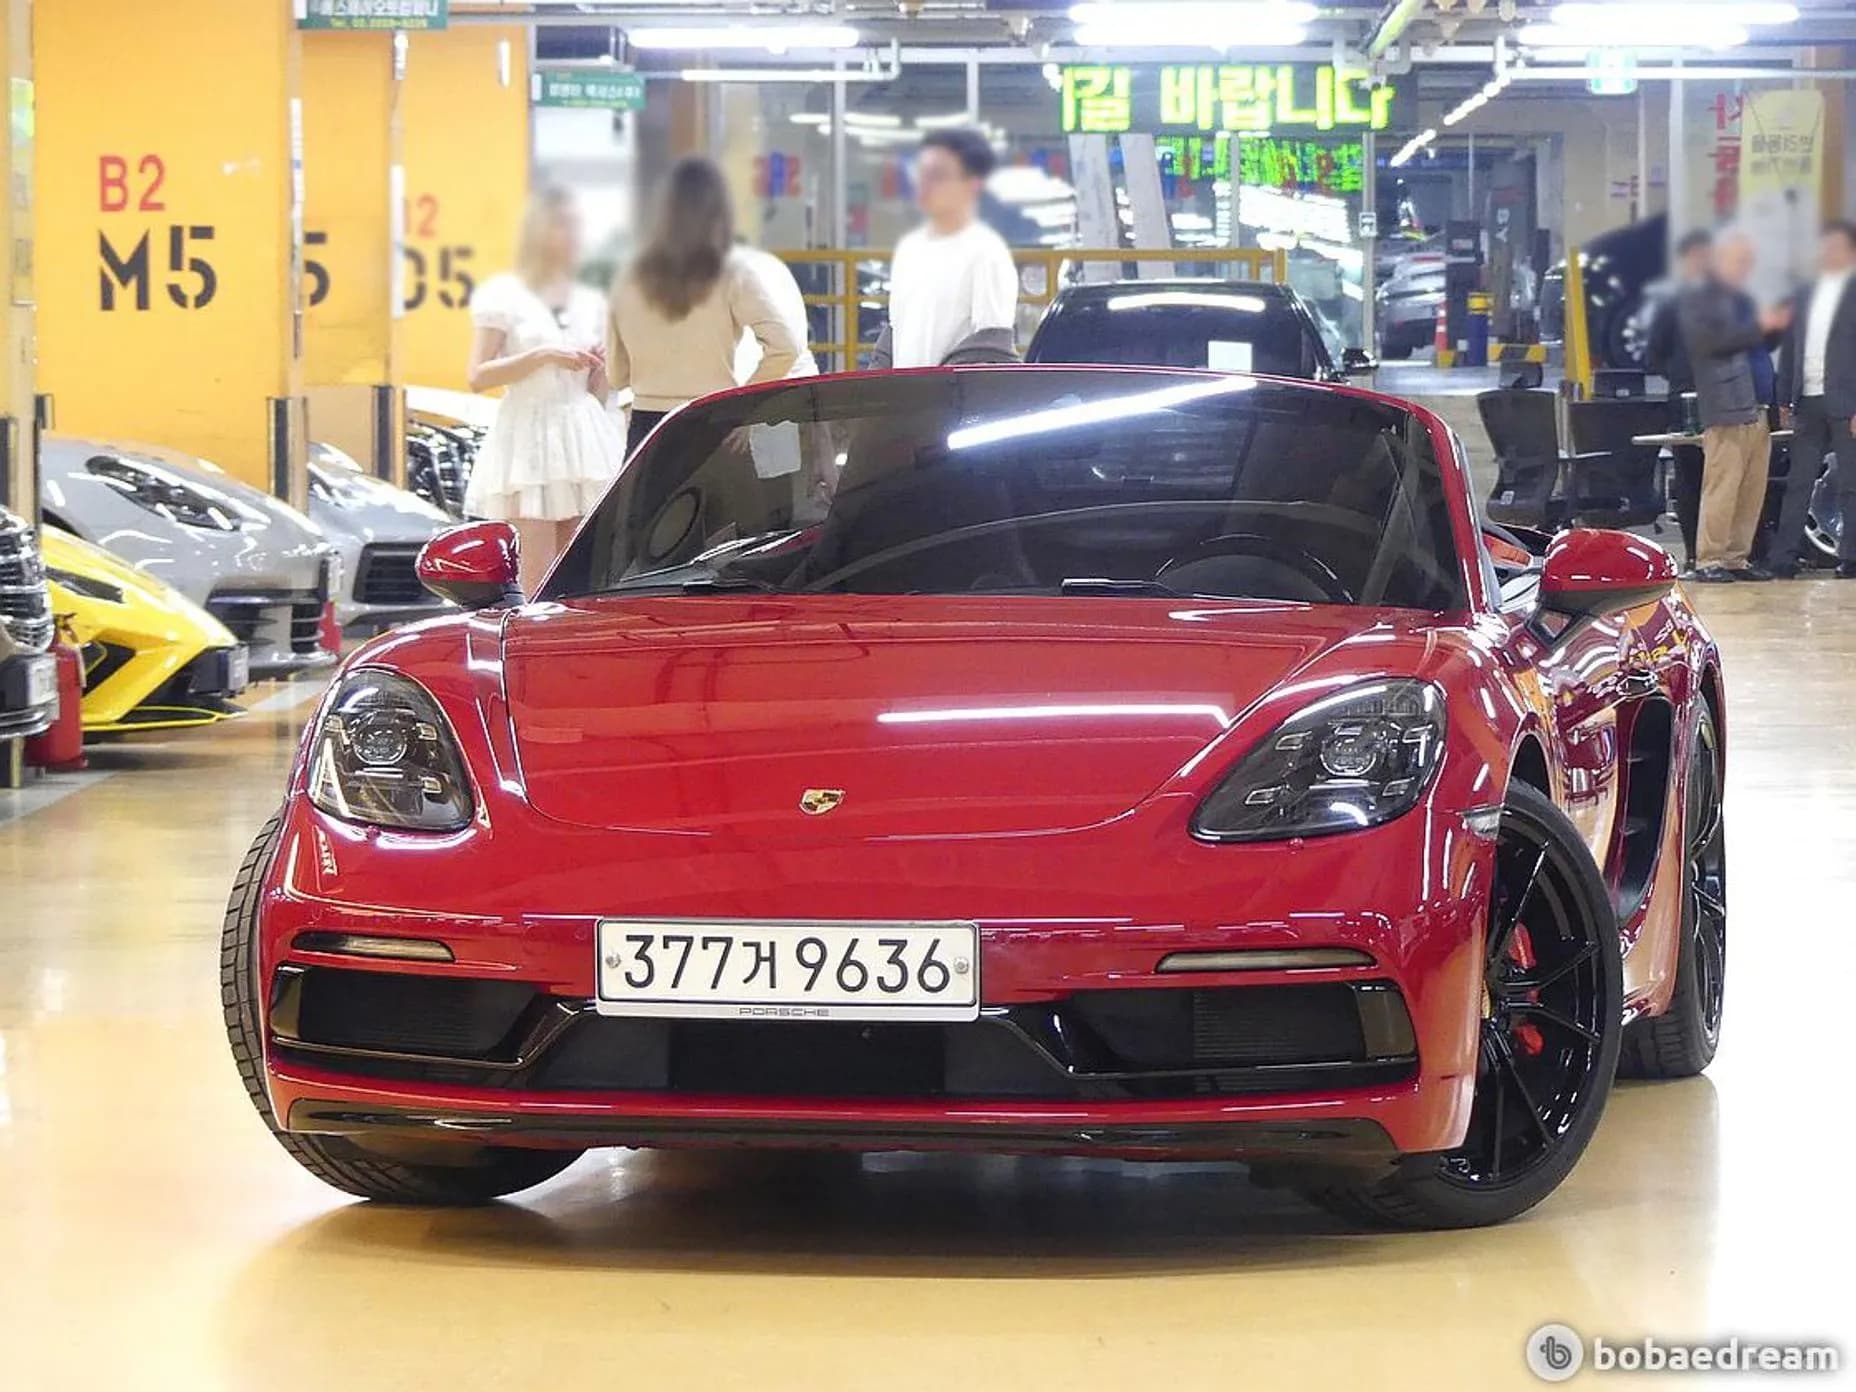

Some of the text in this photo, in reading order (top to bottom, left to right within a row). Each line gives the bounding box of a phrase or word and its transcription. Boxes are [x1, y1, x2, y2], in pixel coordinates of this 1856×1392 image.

[1160, 65, 1396, 131] 바랍니다
[99, 154, 165, 211] B2
[98, 224, 217, 311] M5
[795, 936, 951, 994] 9636
[739, 1007, 830, 1017] PORSCHE
